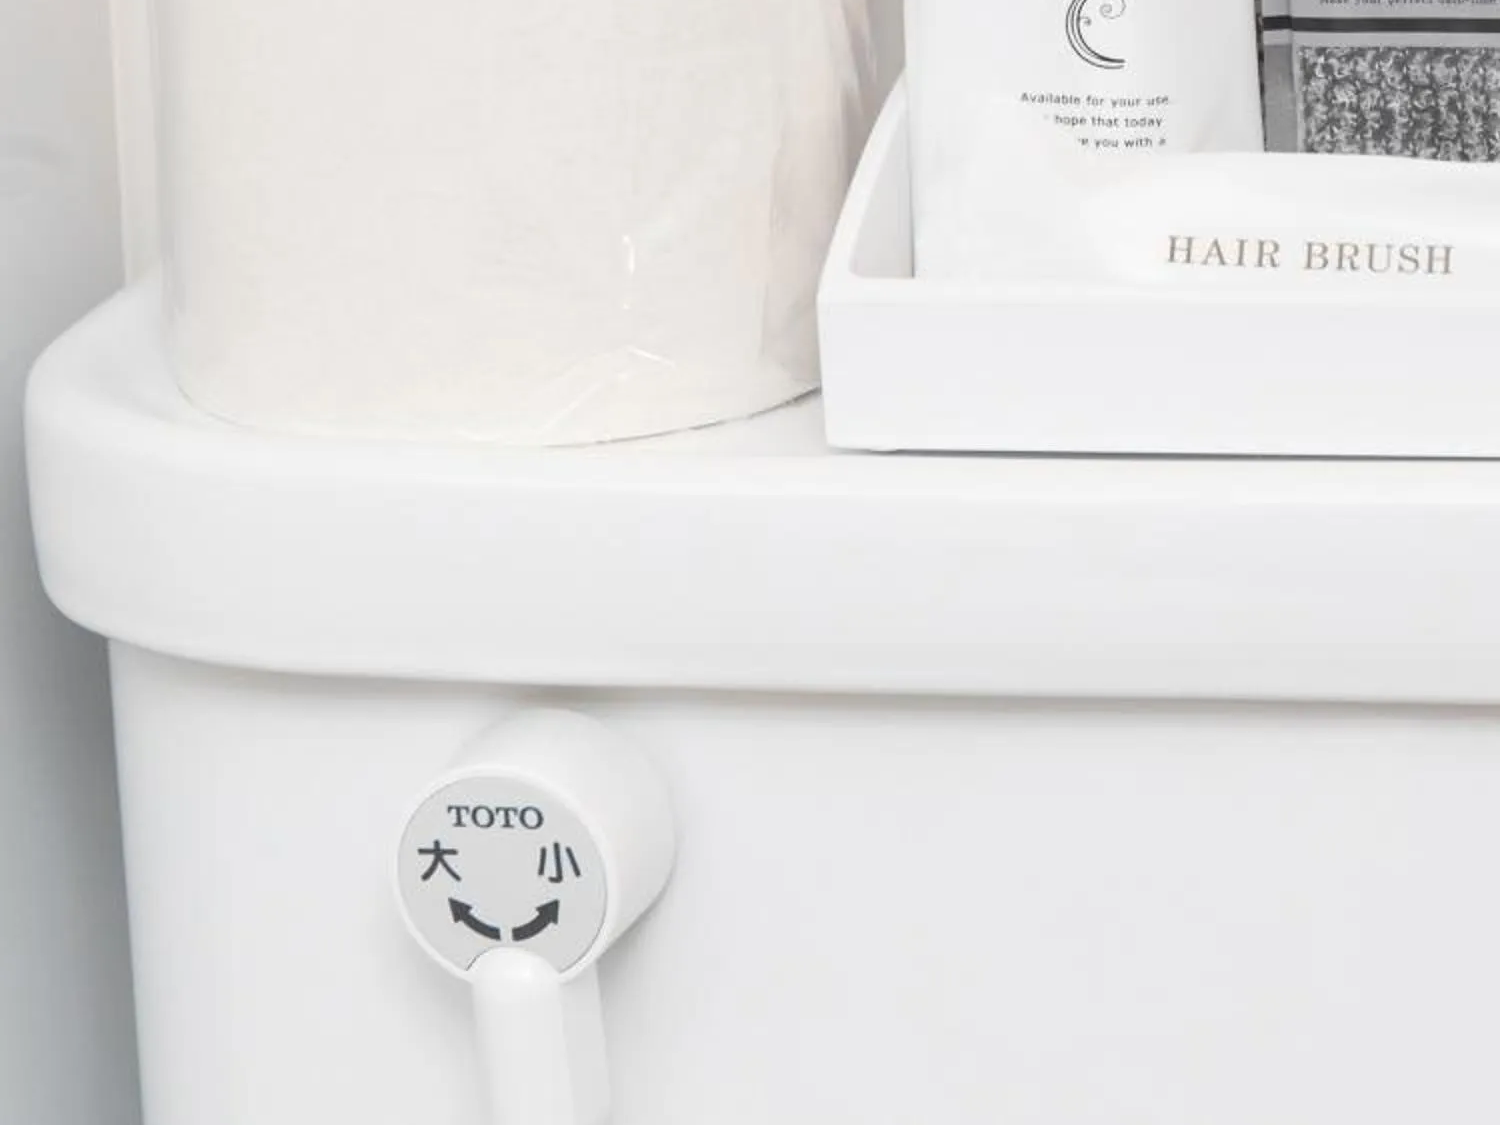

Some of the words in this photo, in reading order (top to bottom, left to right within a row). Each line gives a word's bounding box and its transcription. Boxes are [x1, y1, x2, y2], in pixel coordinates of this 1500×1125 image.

[1020, 92, 1082, 106] Available
[1085, 94, 1105, 107] for
[1110, 96, 1142, 109] your
[1054, 113, 1088, 128] hope
[1090, 115, 1120, 128] that
[1123, 115, 1164, 129] today
[1094, 138, 1120, 150] you
[1123, 136, 1154, 148] with
[1167, 235, 1281, 269] HAIR
[1303, 241, 1455, 276] BRUSH
[446, 804, 545, 830] TOTO
[417, 838, 463, 883] 大
[537, 840, 583, 884] 小
